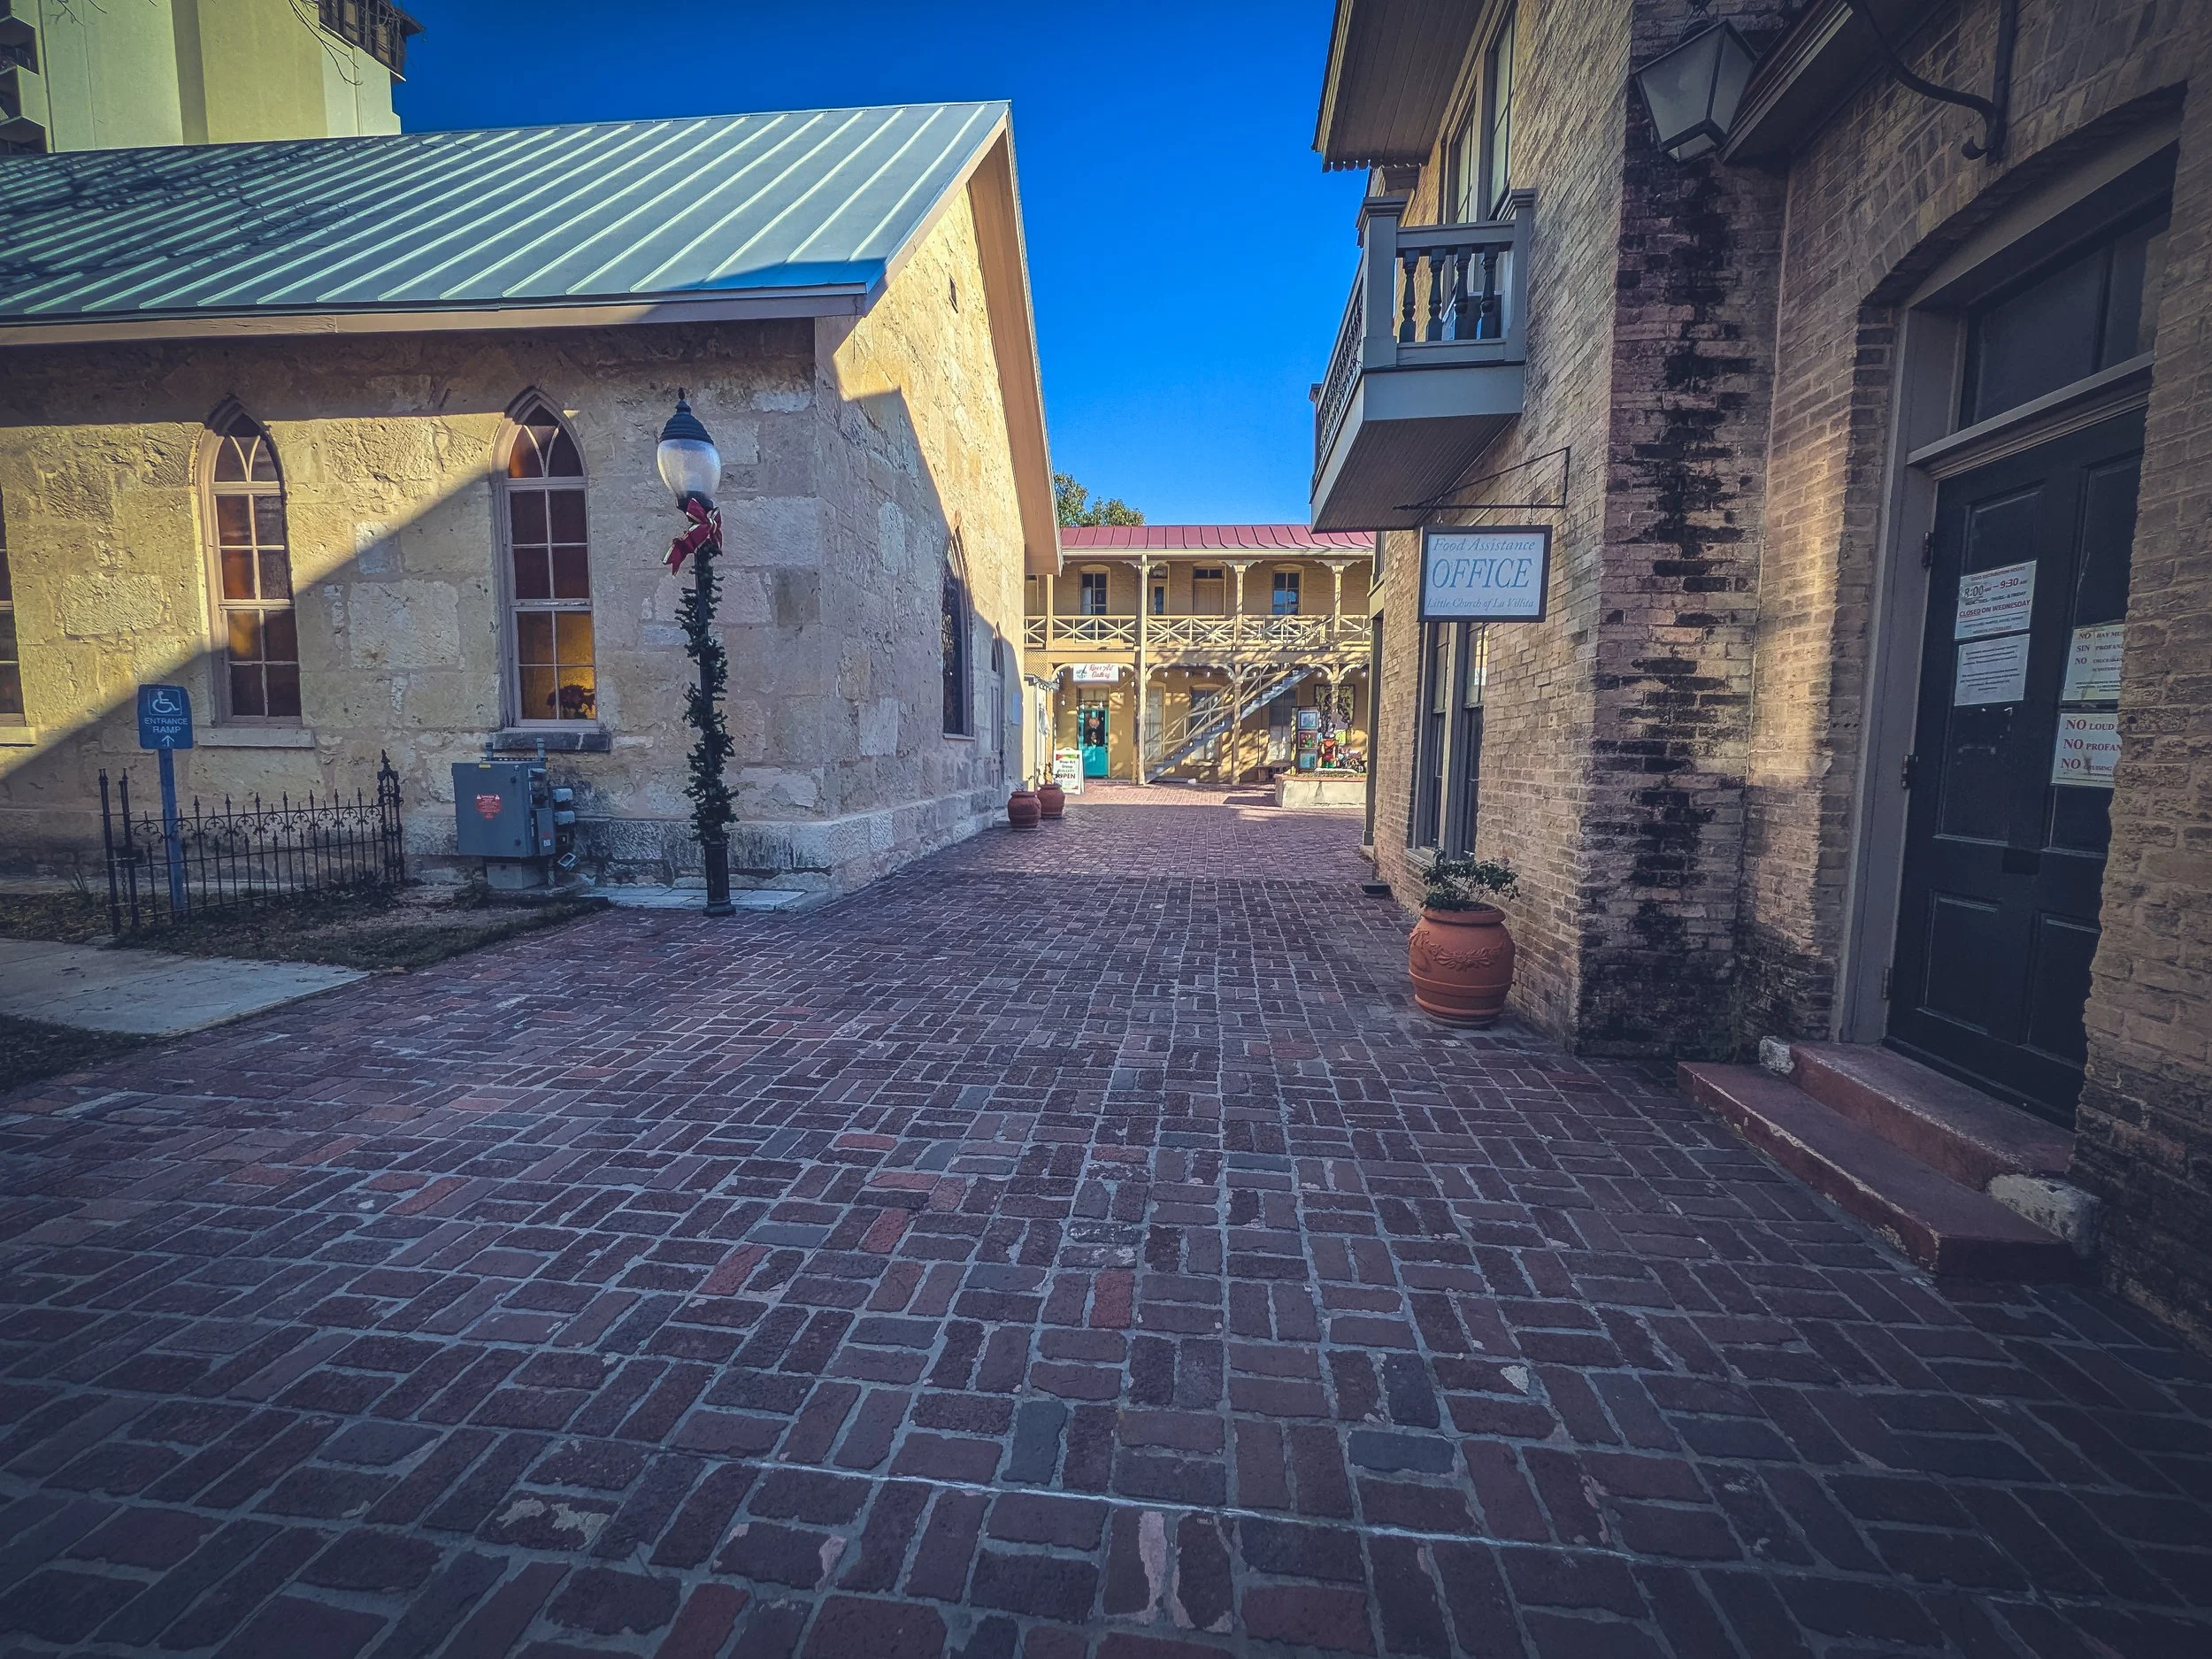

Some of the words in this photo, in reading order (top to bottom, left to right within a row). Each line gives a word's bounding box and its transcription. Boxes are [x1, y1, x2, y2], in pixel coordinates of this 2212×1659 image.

[1432, 537, 1466, 551] Food
[1468, 537, 1536, 551] Assistance
[1432, 557, 1532, 588] OFFICE
[1964, 584, 1984, 598] 8:00
[2000, 577, 2019, 589] 9:30
[1426, 597, 1450, 609] Little
[1452, 597, 1481, 608] Church
[1482, 599, 1492, 611] of
[1493, 597, 1504, 608] La
[1507, 597, 1534, 608] Villita
[1959, 608, 1982, 618] CLOSED
[1992, 599, 2031, 612] WEDNESDAY
[2074, 657, 2088, 665] NO
[144, 717, 188, 726] ENTRANCE
[2065, 718, 2086, 731] NO
[2062, 738, 2085, 750] NO
[2061, 757, 2081, 770] NO
